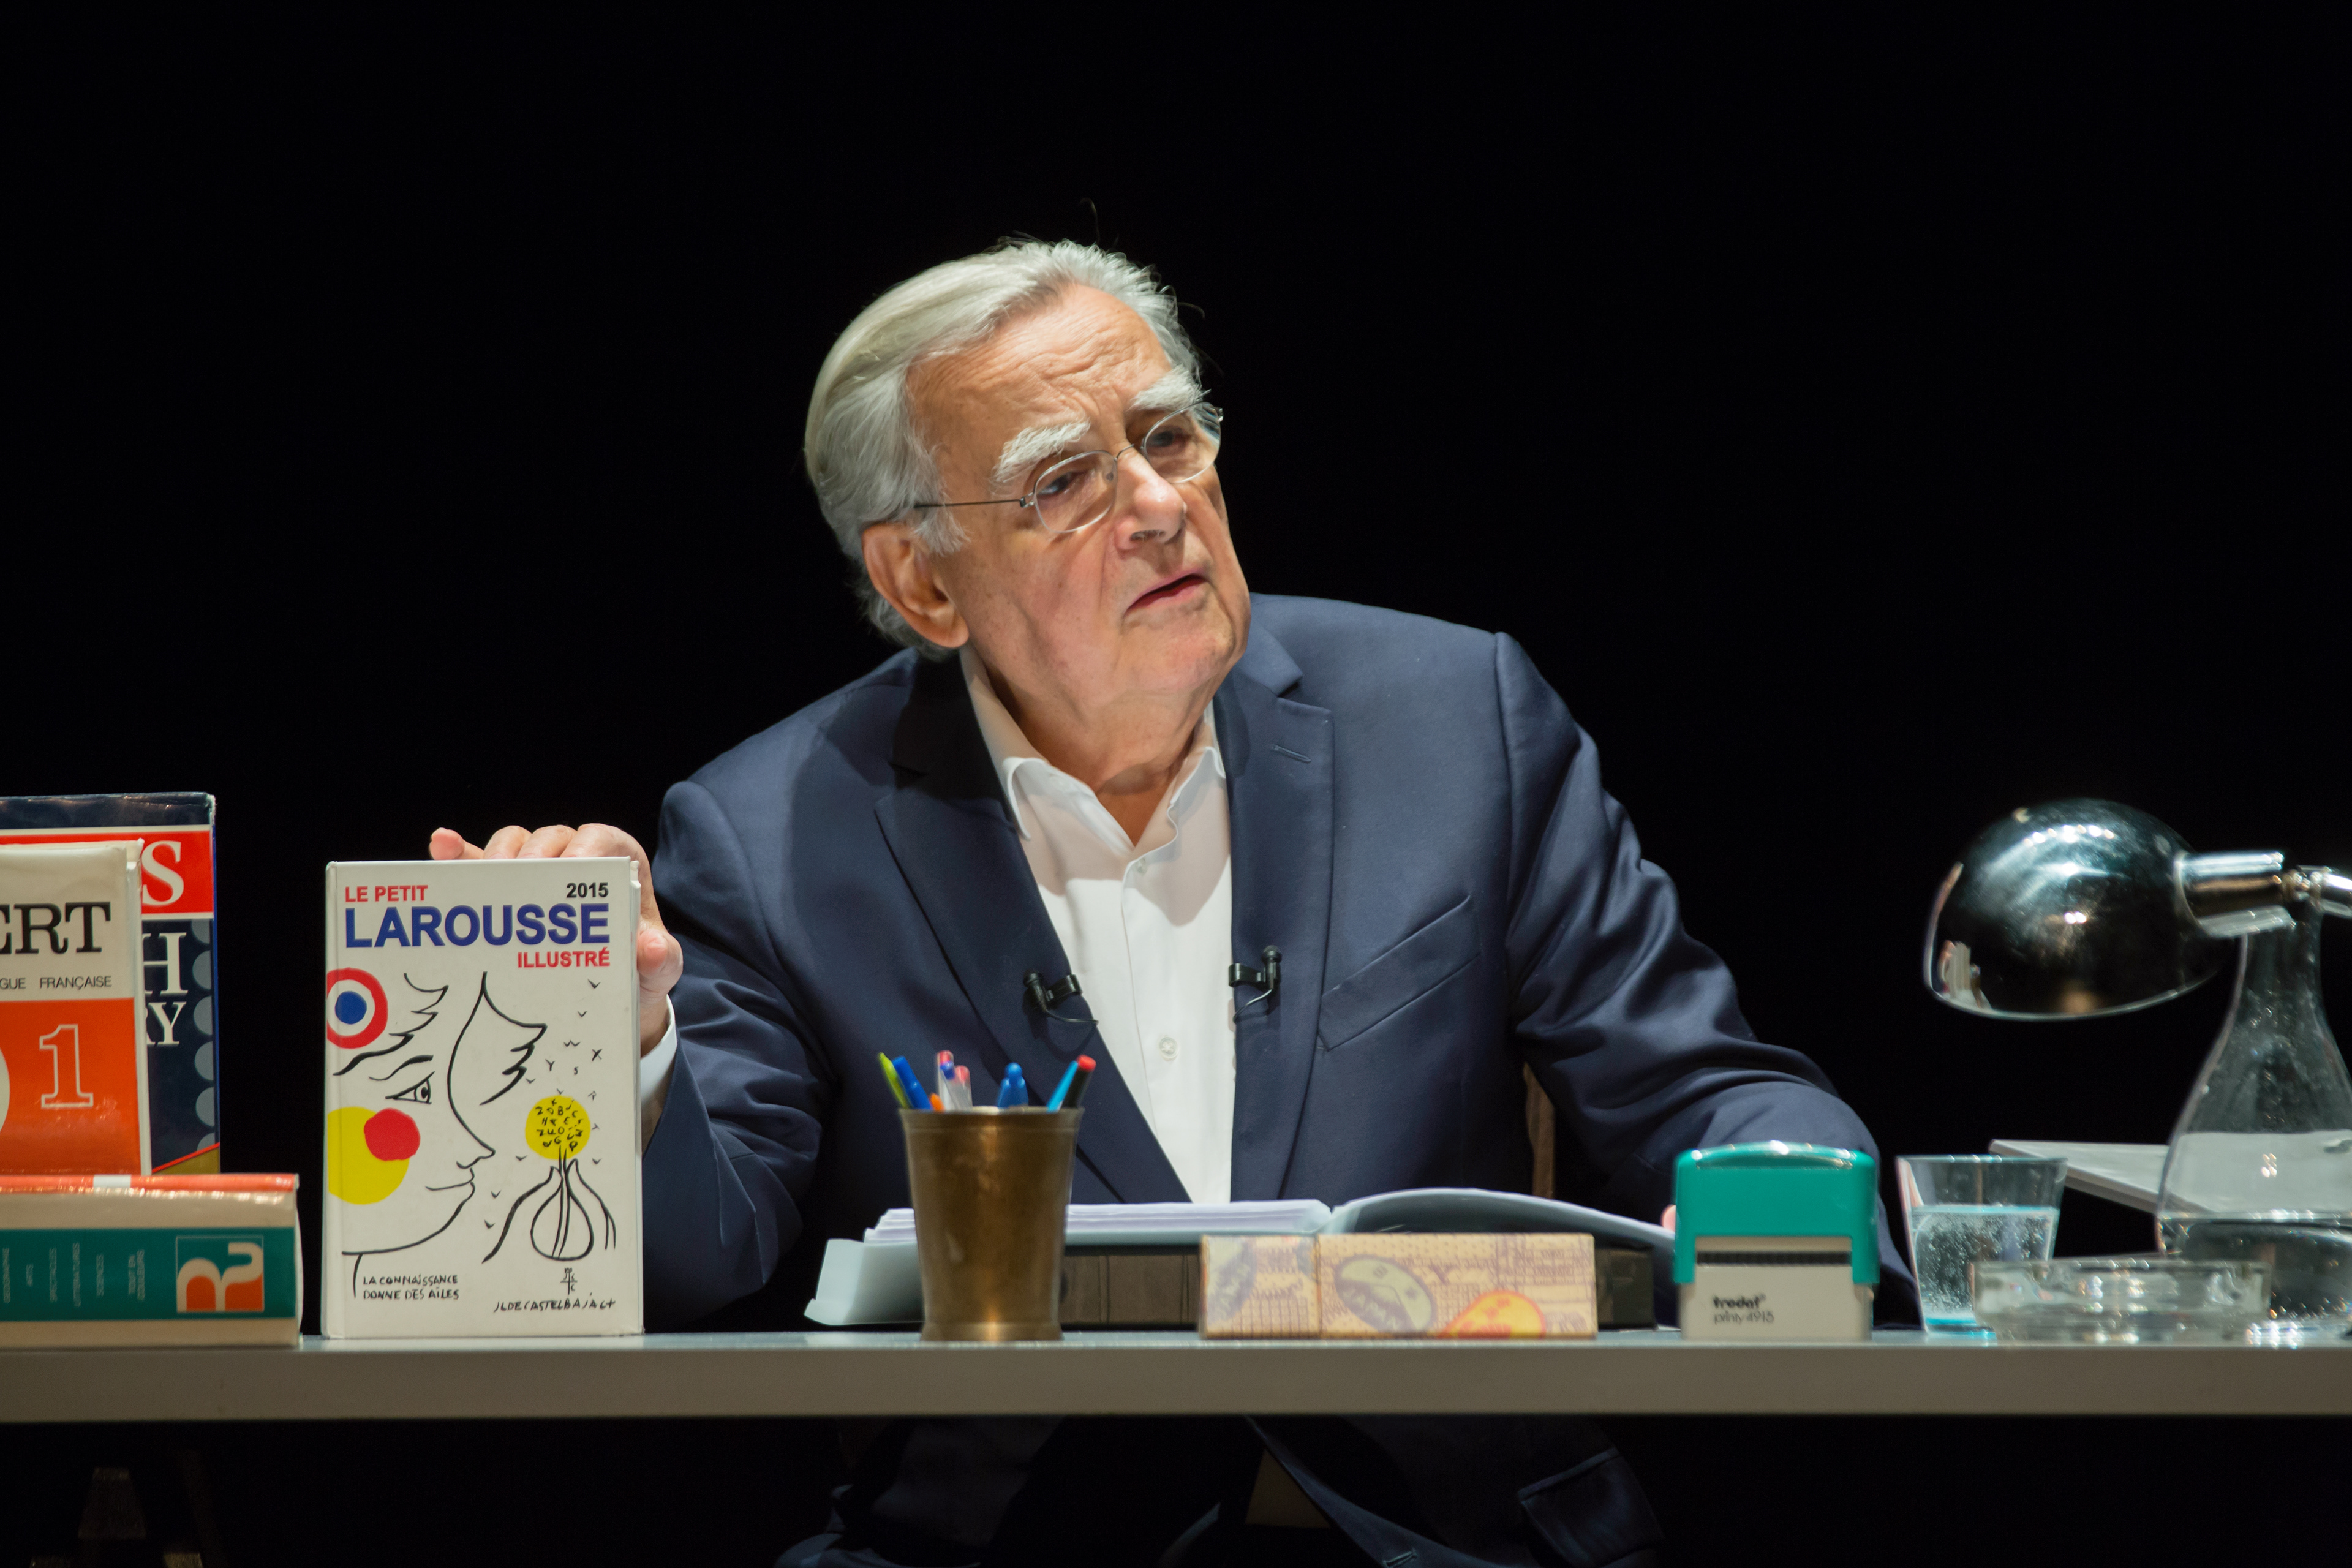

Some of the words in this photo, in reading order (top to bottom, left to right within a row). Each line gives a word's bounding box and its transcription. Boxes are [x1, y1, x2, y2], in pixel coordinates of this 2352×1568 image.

[345, 886, 368, 902] LE
[375, 884, 429, 902] PETIT
[566, 882, 609, 899] 2015
[0, 901, 111, 954] RT
[345, 903, 611, 948] LAROUSSE
[517, 947, 611, 969] ILLUSTRÉ
[39, 976, 112, 991] FRANÇAISE
[39, 1023, 94, 1109] 1
[363, 1276, 377, 1285] LA
[363, 1289, 401, 1300] DONNE
[405, 1287, 424, 1300] DES
